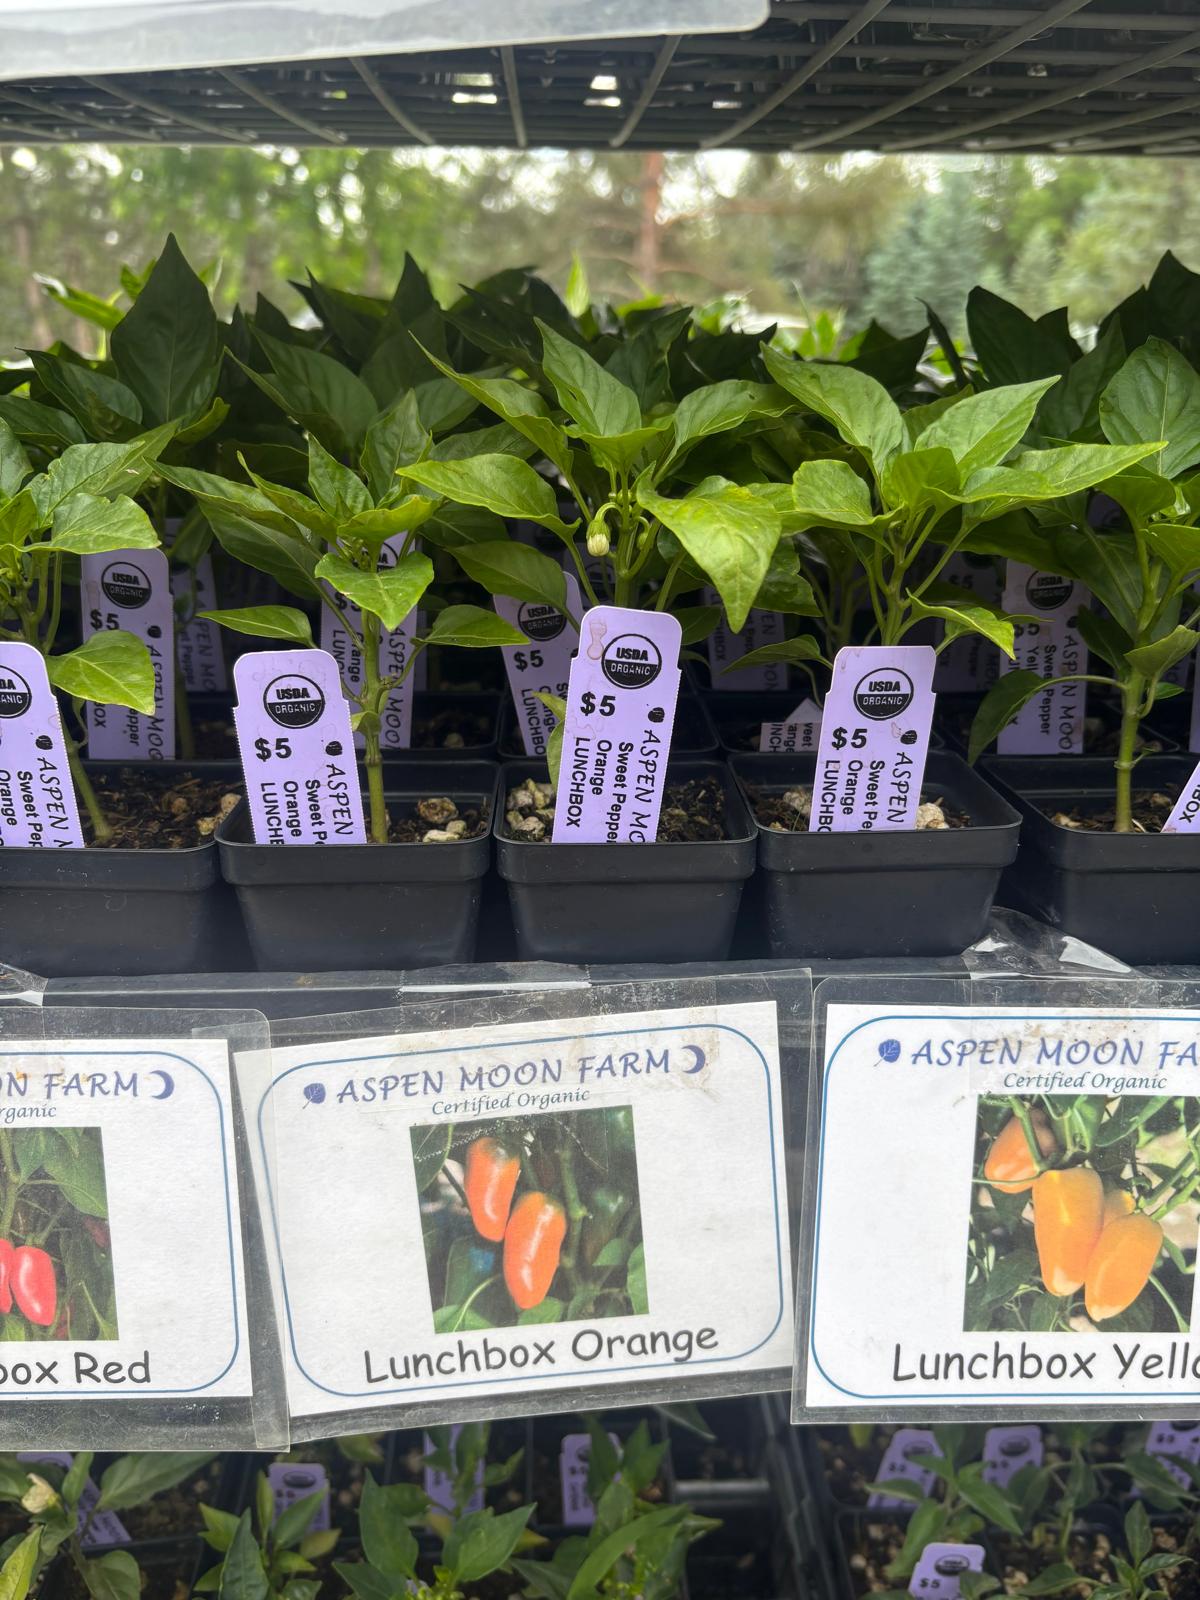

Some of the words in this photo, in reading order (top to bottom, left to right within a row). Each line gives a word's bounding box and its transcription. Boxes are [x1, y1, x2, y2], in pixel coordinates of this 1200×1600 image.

[112, 572, 140, 586] USDA
[90, 609, 119, 630] $5
[527, 605, 555, 619] USDA
[514, 650, 544, 671] $5
[610, 663, 651, 676] ORGANIC
[616, 647, 649, 661] USDA
[1062, 635, 1079, 697] ASPN
[275, 688, 310, 700] USDA
[863, 696, 903, 705] ORGANIC
[868, 681, 901, 692] USDA
[275, 703, 316, 714] ORGANIC
[580, 691, 616, 717] $5
[1038, 689, 1055, 735] Pepper
[254, 737, 292, 762] $5
[831, 727, 868, 750] $5
[589, 739, 612, 796] Orange
[614, 741, 634, 788] Sweet
[634, 729, 661, 803] ASPEN
[17, 771, 40, 818] Sweet
[37, 757, 69, 830] ASPEN
[326, 763, 354, 835] ASPEN
[566, 737, 591, 828] LUNCHBOX
[840, 760, 863, 815] Orange
[864, 760, 885, 806] Sweet
[887, 752, 913, 823] ASPEN
[283, 780, 302, 837] Orange
[305, 779, 325, 827] Sweet
[911, 1038, 1023, 1067] ASPEN
[1036, 1037, 1143, 1067] MOON
[44, 1070, 139, 1100] FARM
[336, 1070, 443, 1104] ASPEN
[459, 1058, 562, 1092] MOON
[577, 1048, 670, 1083] FARM
[1004, 1071, 1089, 1090] Certified
[1091, 1072, 1168, 1092] Organic
[432, 1092, 511, 1117] Certified
[517, 1087, 590, 1112] Organic
[74, 1350, 151, 1384] Red
[364, 1338, 556, 1384] Lunchbox
[571, 1327, 719, 1363] Orange
[892, 1341, 1097, 1382] Lunchbox
